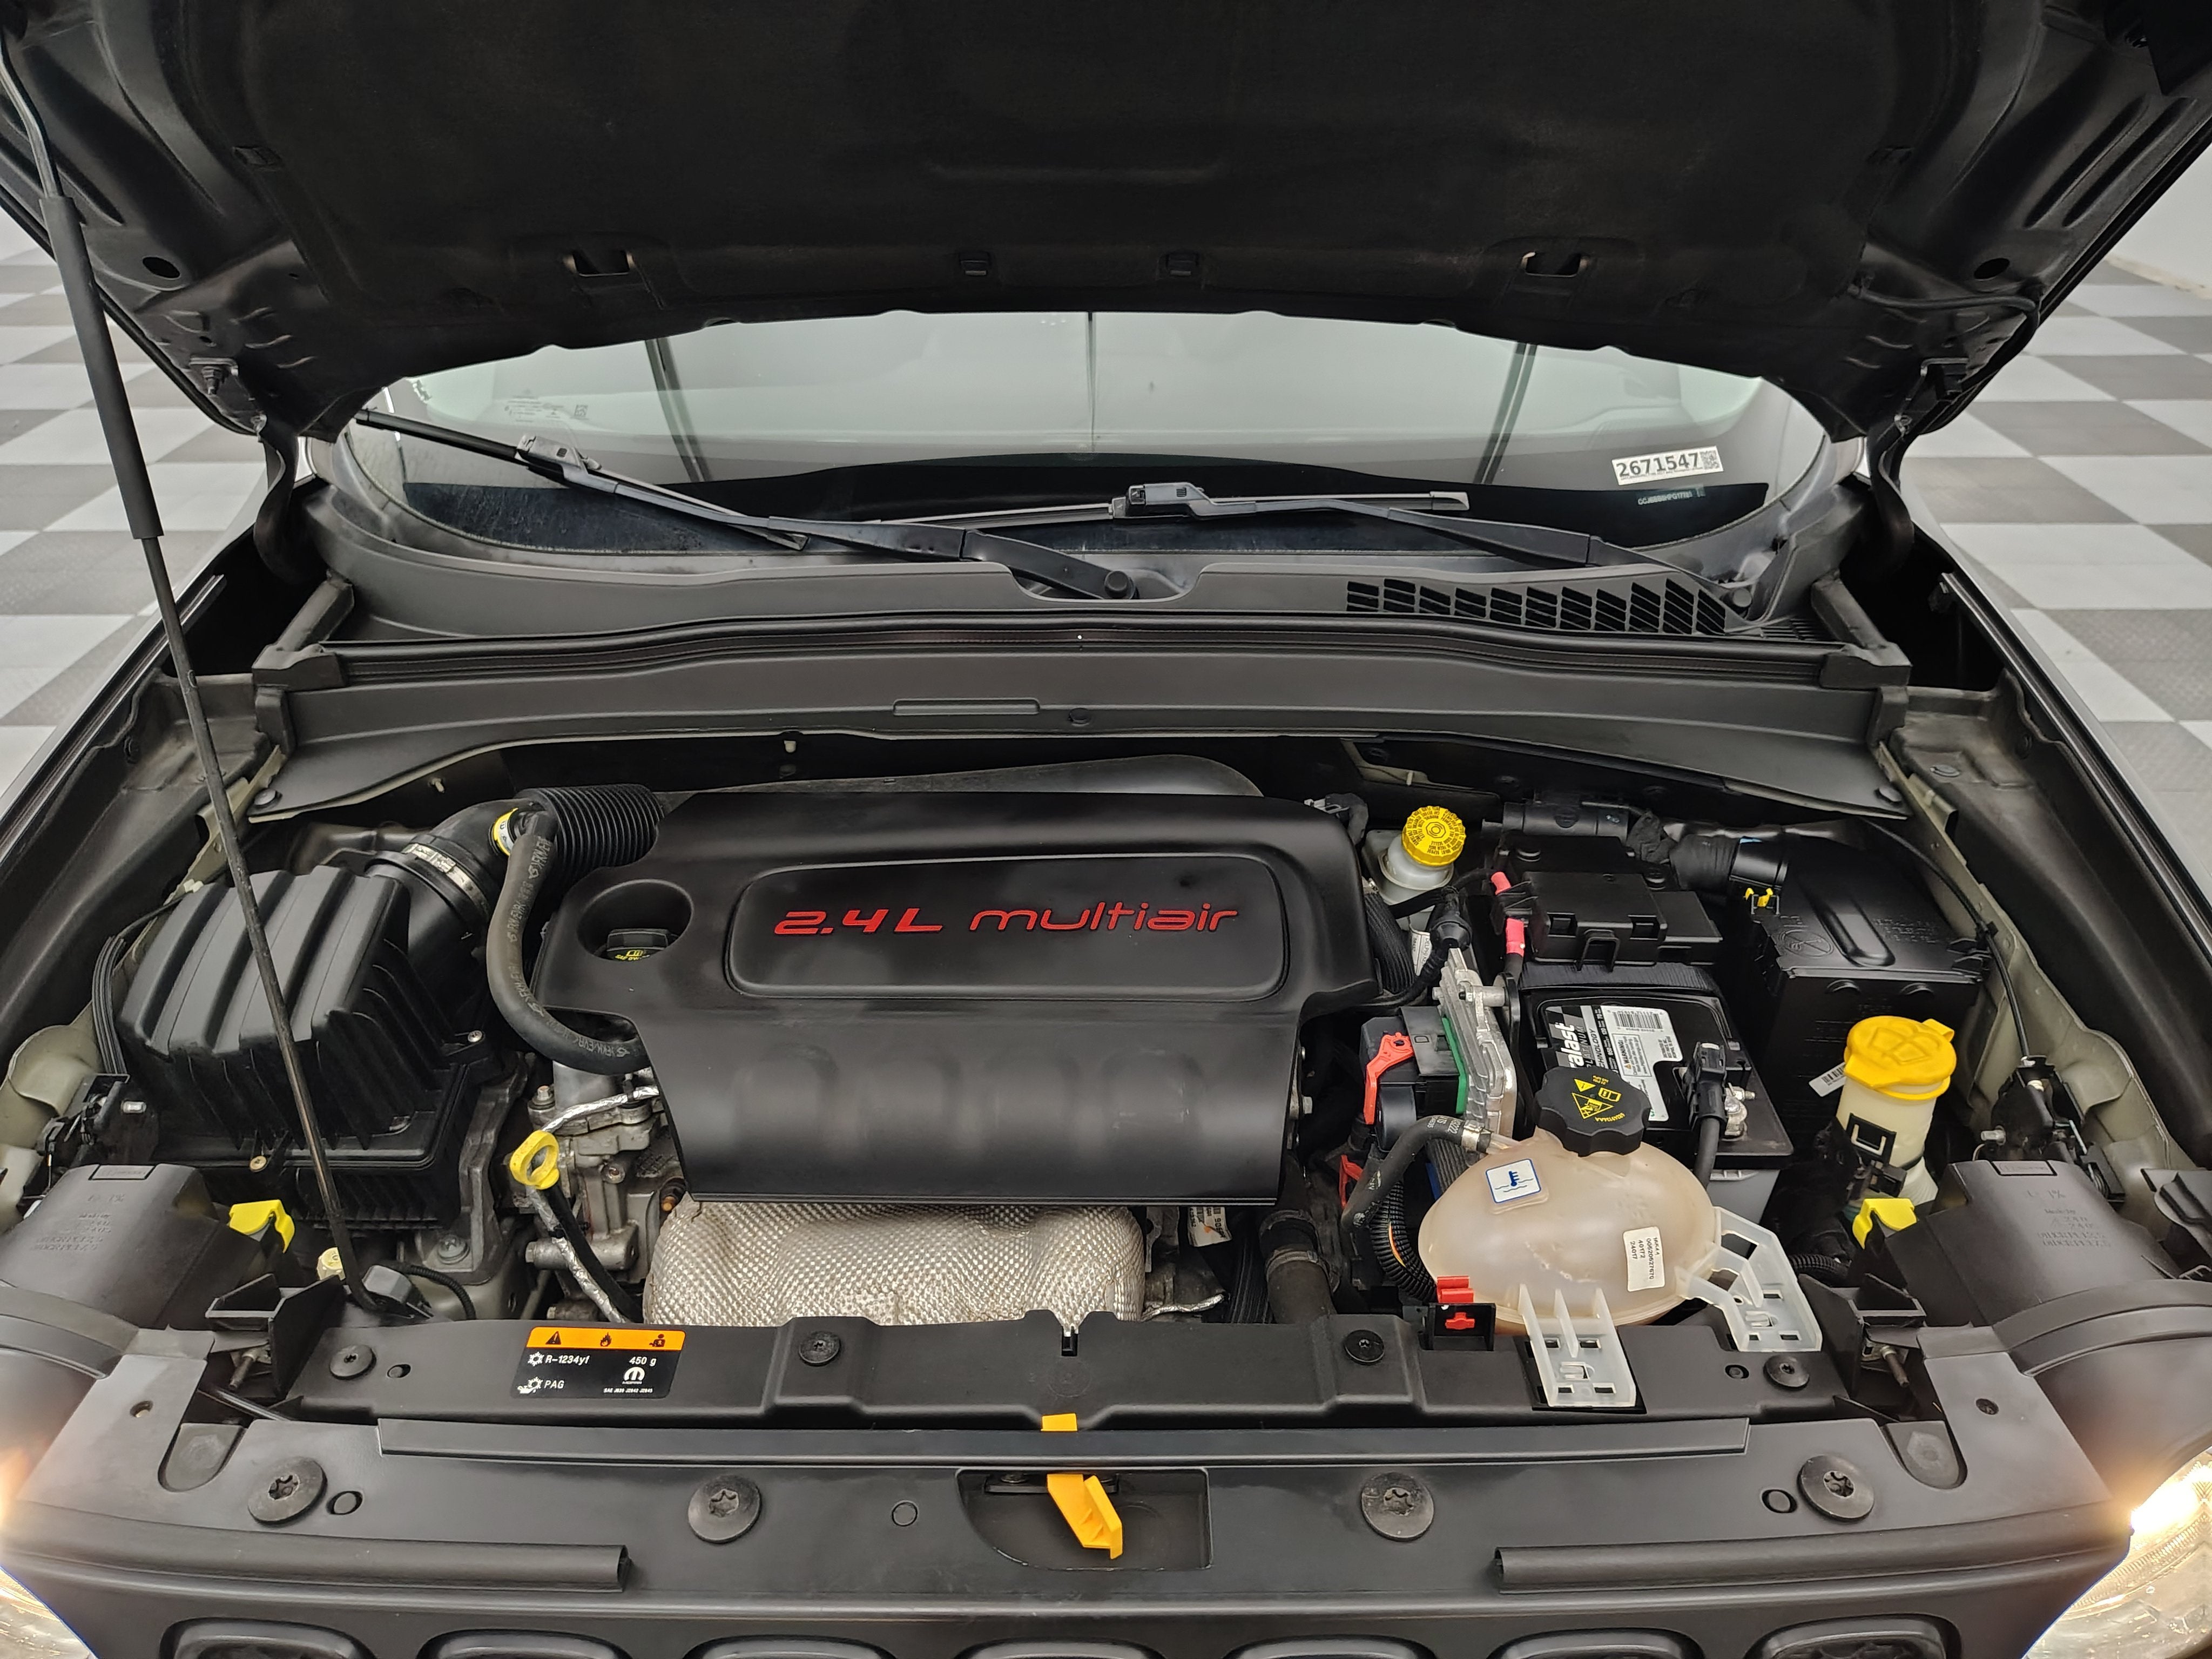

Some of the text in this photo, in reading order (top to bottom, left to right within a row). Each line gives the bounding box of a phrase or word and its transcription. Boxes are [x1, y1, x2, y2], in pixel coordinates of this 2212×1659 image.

[1616, 452, 1700, 477] 2671547
[970, 901, 1239, 932] multiair
[545, 1354, 657, 1367] R-1234yf 450 g
[544, 1380, 565, 1389] PAG
